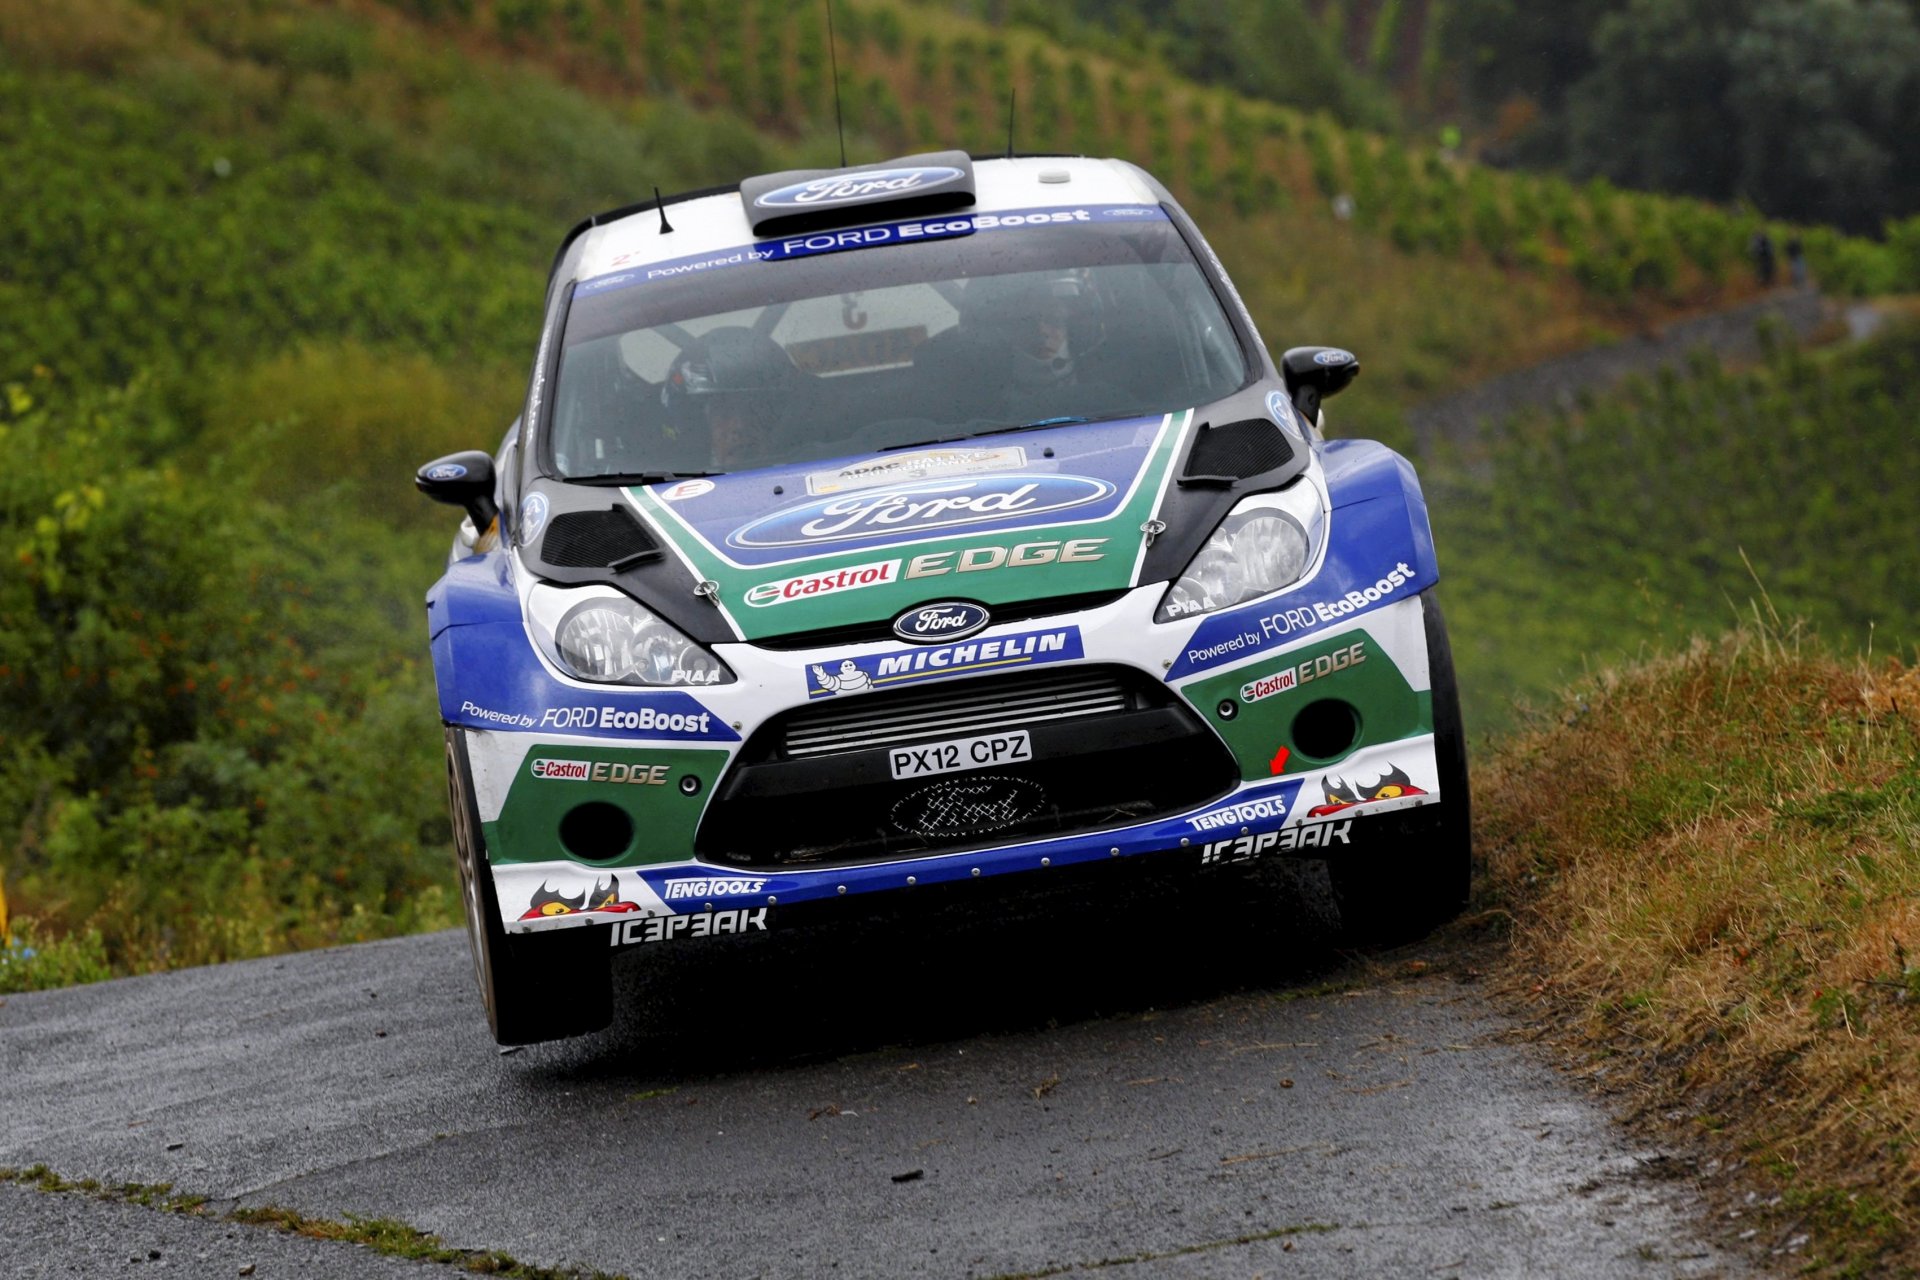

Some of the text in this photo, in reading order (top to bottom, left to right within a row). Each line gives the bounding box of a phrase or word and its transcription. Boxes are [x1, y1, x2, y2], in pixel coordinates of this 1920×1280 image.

[796, 171, 923, 201] Ford
[647, 208, 1091, 280] Powered by FORD EcoBoost
[838, 462, 900, 478] ADAC
[676, 484, 700, 498] E
[801, 482, 1038, 537] Ford
[783, 538, 1110, 600] Castrol EDGE
[914, 608, 968, 633] Ford
[1165, 598, 1217, 617] PIAA
[1188, 561, 1416, 664] Powered by FORD EcoBoost
[878, 632, 1066, 677] MICHELIN
[1255, 641, 1367, 698] Castrol EDGE
[671, 669, 720, 684] PIAA
[461, 700, 710, 734] Powered by FORD EcoBoost
[894, 735, 1028, 776] PX12 CPZ
[545, 761, 671, 785] Castrol EDGE
